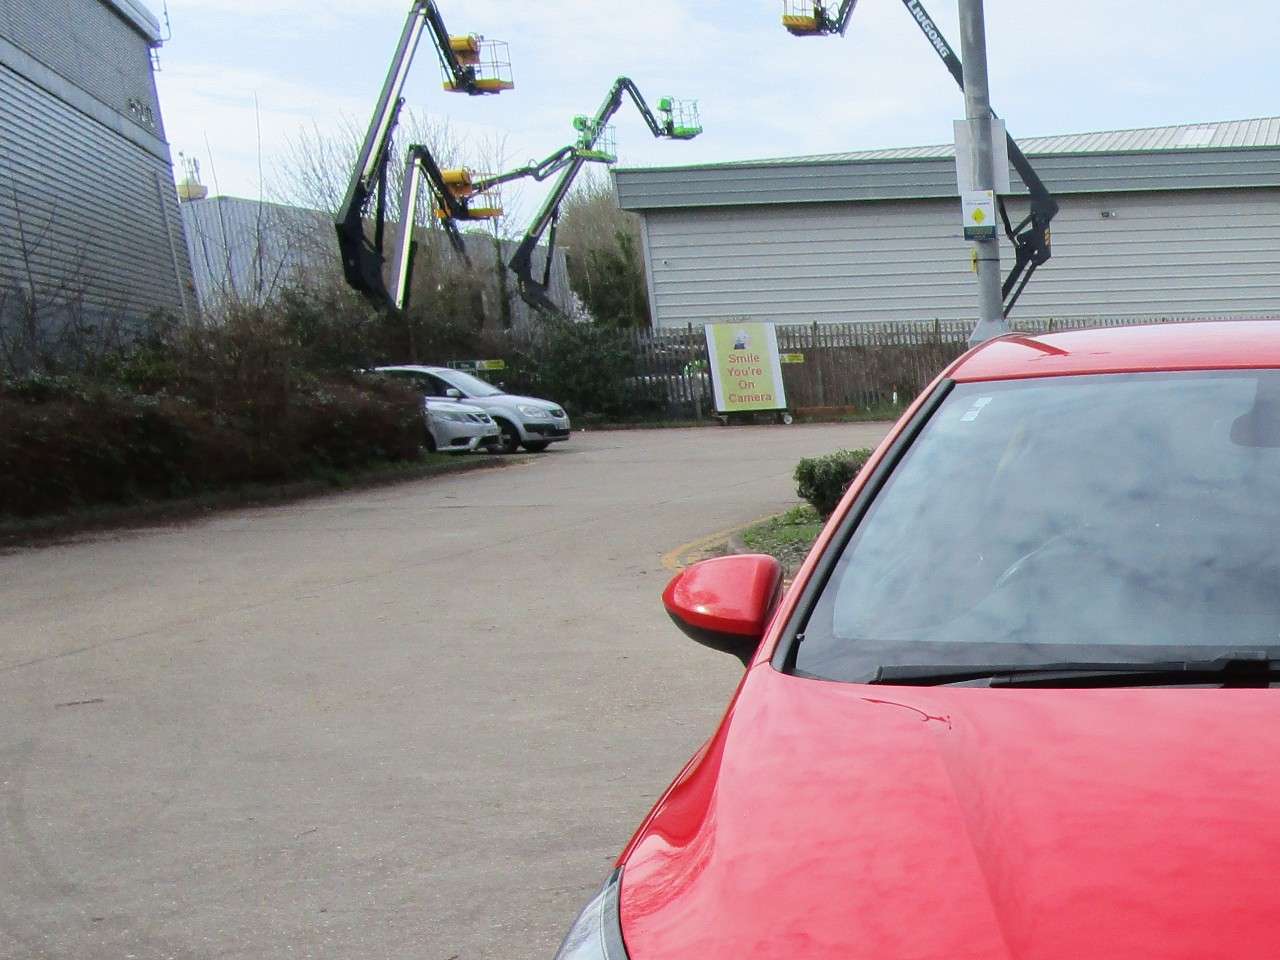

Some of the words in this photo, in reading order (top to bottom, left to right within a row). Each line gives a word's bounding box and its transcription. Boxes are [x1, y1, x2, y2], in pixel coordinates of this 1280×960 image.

[728, 353, 760, 364] Smile
[727, 367, 763, 377] You're
[738, 380, 755, 390] On
[728, 393, 772, 404] Camera
